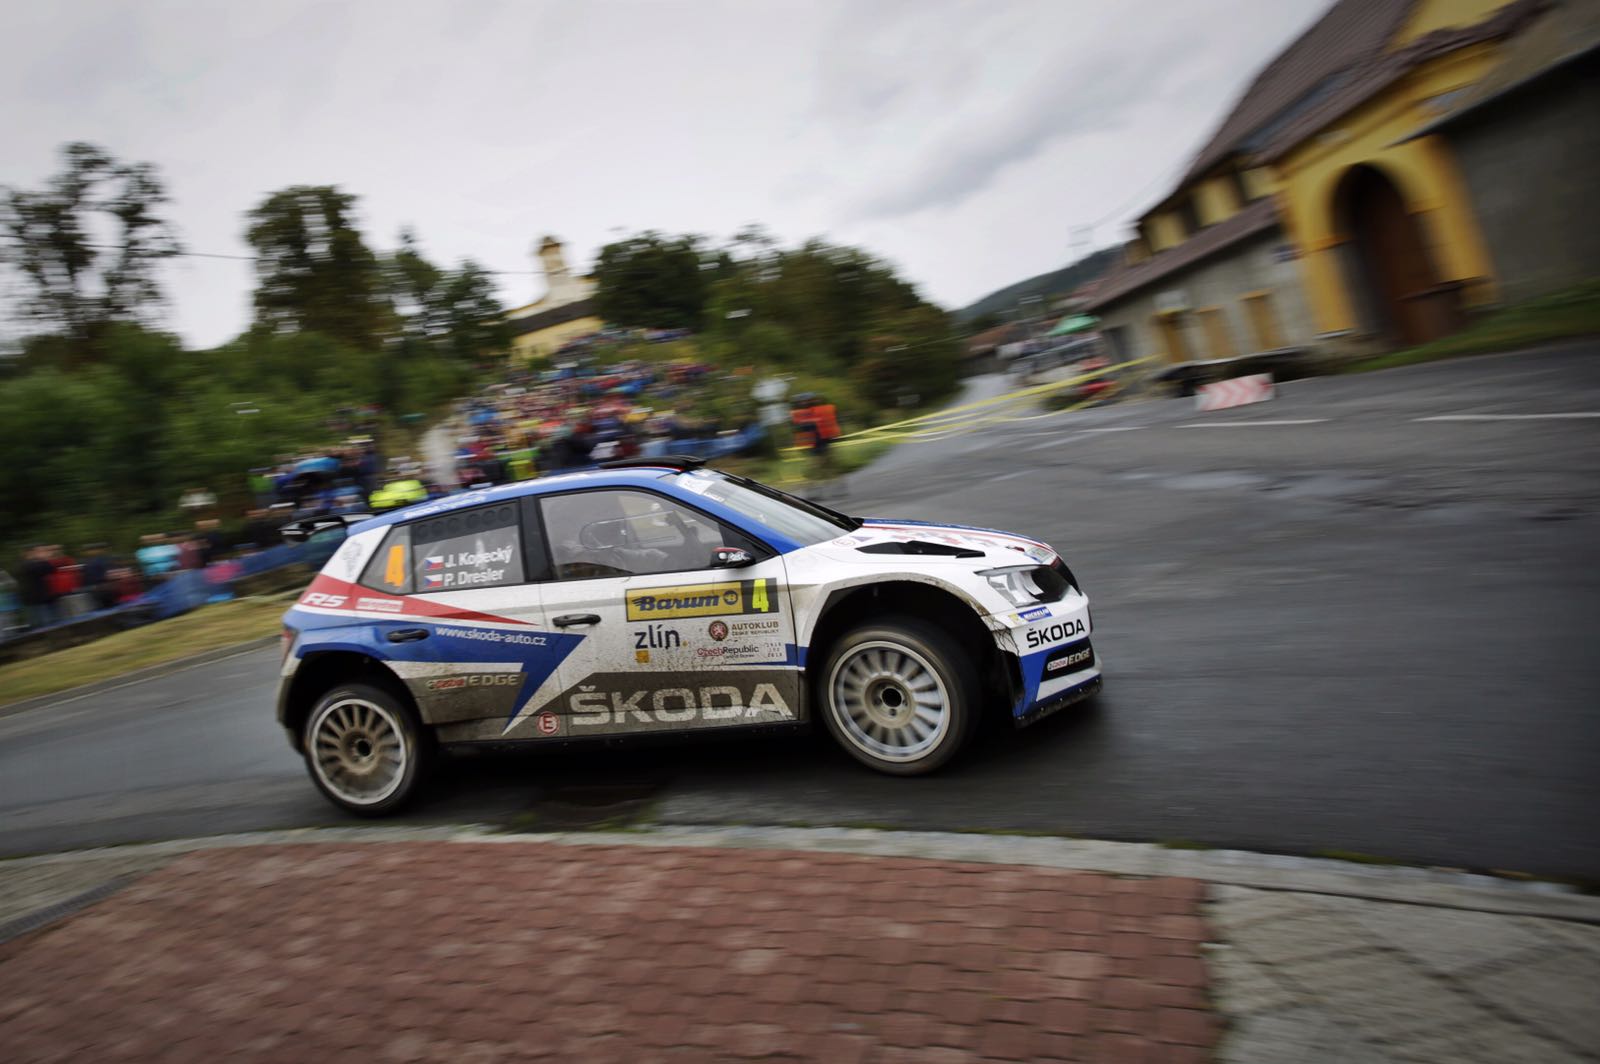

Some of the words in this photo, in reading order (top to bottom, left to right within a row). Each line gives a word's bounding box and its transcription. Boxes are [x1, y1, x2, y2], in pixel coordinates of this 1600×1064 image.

[384, 544, 405, 588] 4
[445, 554, 457, 568] J.
[459, 545, 513, 568] Kopecký
[444, 574, 456, 586] P.
[458, 568, 504, 584] Dresler
[632, 594, 720, 611] Barum
[752, 578, 769, 612] 4
[731, 621, 779, 630] AUTOKLUB
[1026, 618, 1085, 648] ŠKODA
[1068, 648, 1090, 665] EDGE
[468, 674, 520, 686] EDGE
[569, 683, 793, 726] ŠKODA
